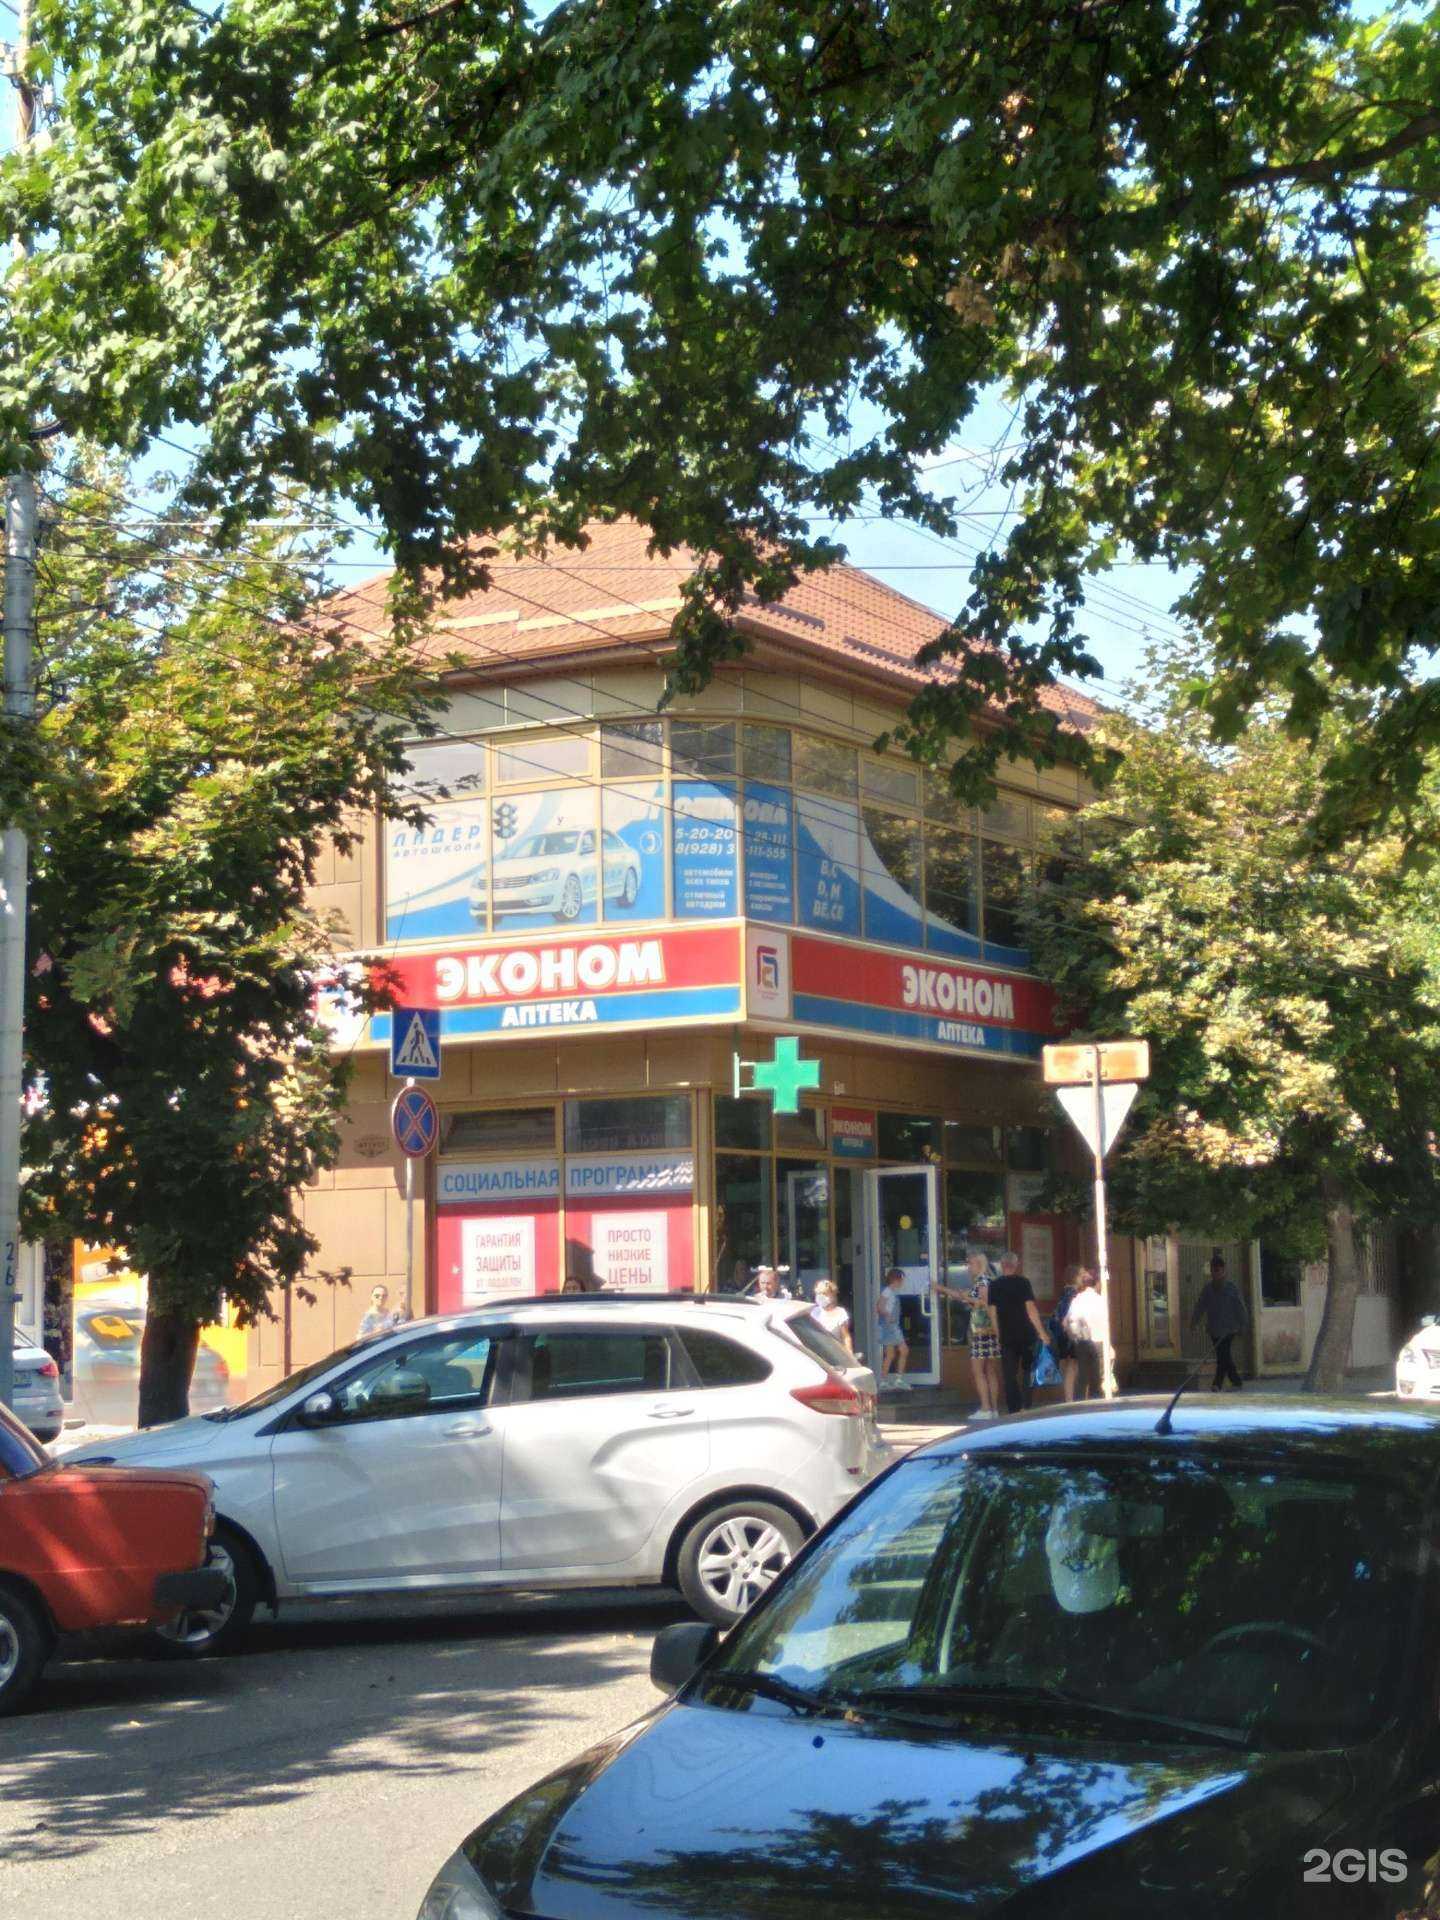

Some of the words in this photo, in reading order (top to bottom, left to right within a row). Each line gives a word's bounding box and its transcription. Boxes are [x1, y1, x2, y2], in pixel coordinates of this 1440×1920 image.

[393, 825, 480, 846] ЛИДЕР
[434, 939, 666, 1002] ЭКОНОМ
[902, 965, 1015, 1020] ЭКОНОМ
[501, 1000, 599, 1028] АПТЕКА
[937, 1020, 986, 1046] АПТЕКА
[443, 1169, 560, 1193] СОЦИАЛЬНАЯ
[475, 1231, 522, 1250] ГАРАНТИЯ
[607, 1228, 651, 1243] ПРОСТО
[475, 1255, 522, 1274] ЗАЩИТЫ
[607, 1248, 651, 1262] НИЗКИЕ
[608, 1267, 653, 1286] ЦЕНЫ
